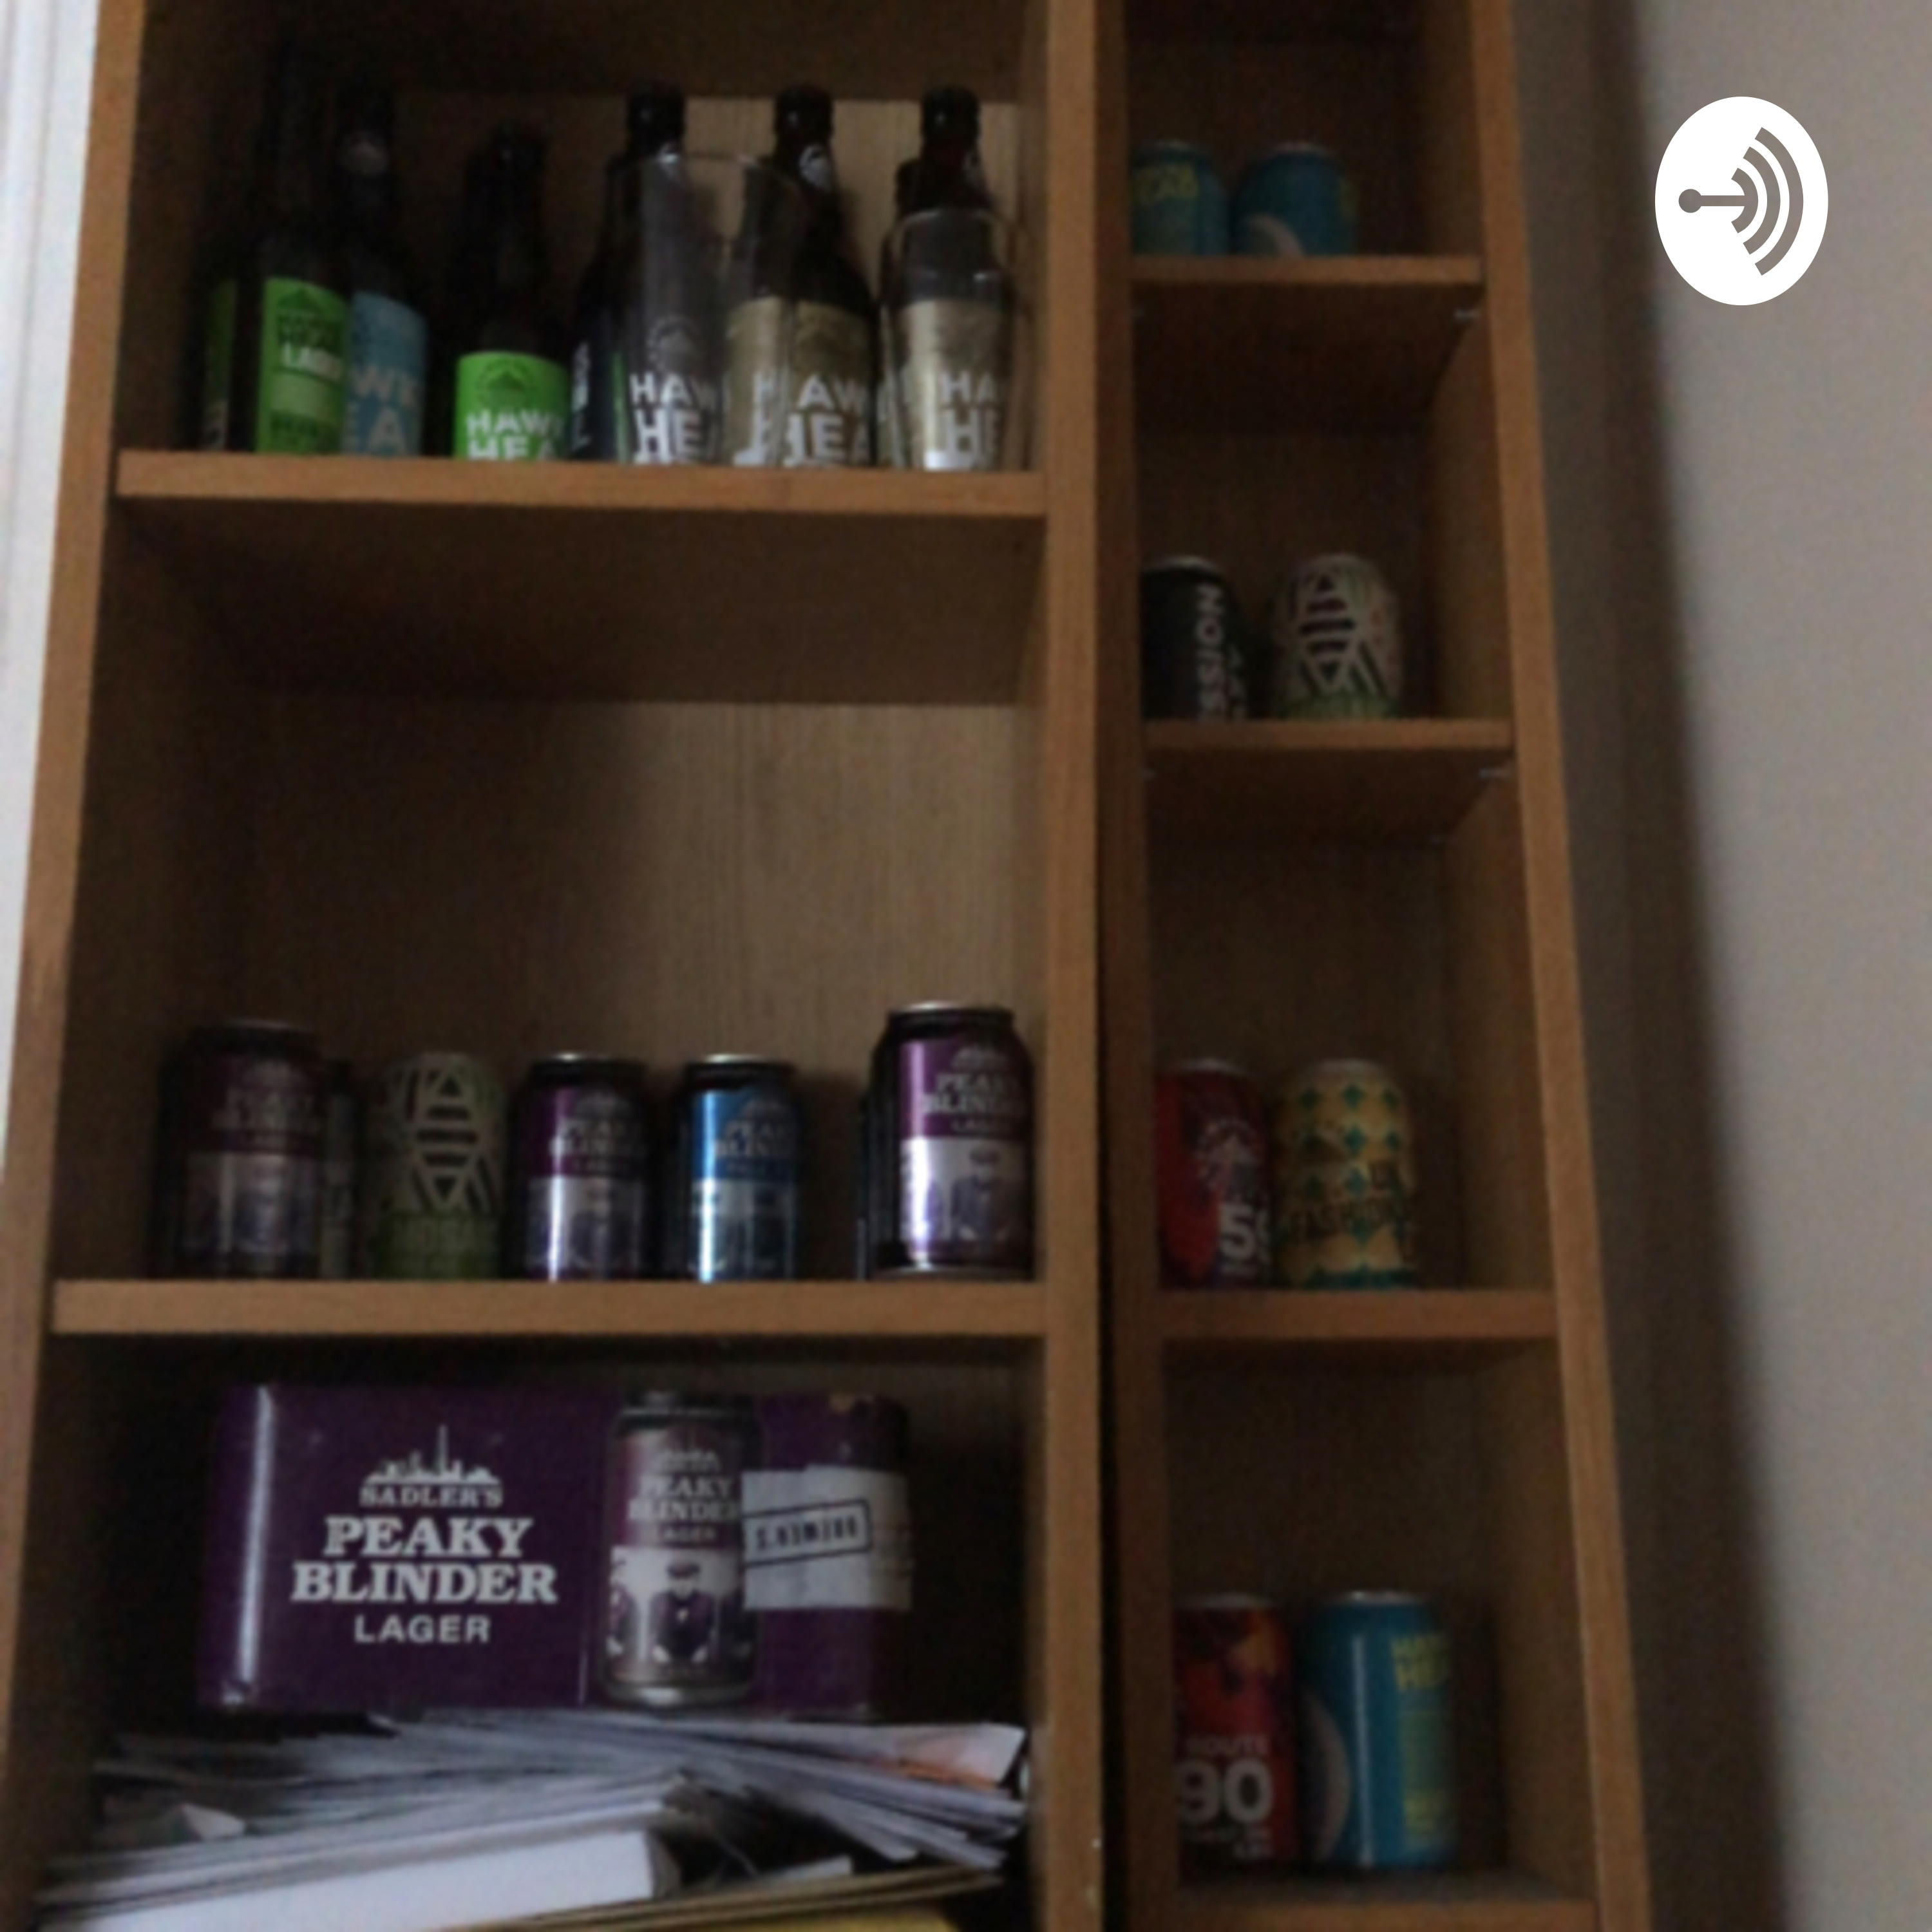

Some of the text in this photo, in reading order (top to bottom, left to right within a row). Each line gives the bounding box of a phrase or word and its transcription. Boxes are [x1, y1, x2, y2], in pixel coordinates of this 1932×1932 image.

[359, 1485, 504, 1509] SADLER'S
[321, 1514, 533, 1558] PEAKY
[290, 1560, 559, 1604] BLINDER
[354, 1614, 491, 1644] LAGER
[1173, 1759, 1276, 1825] 90
